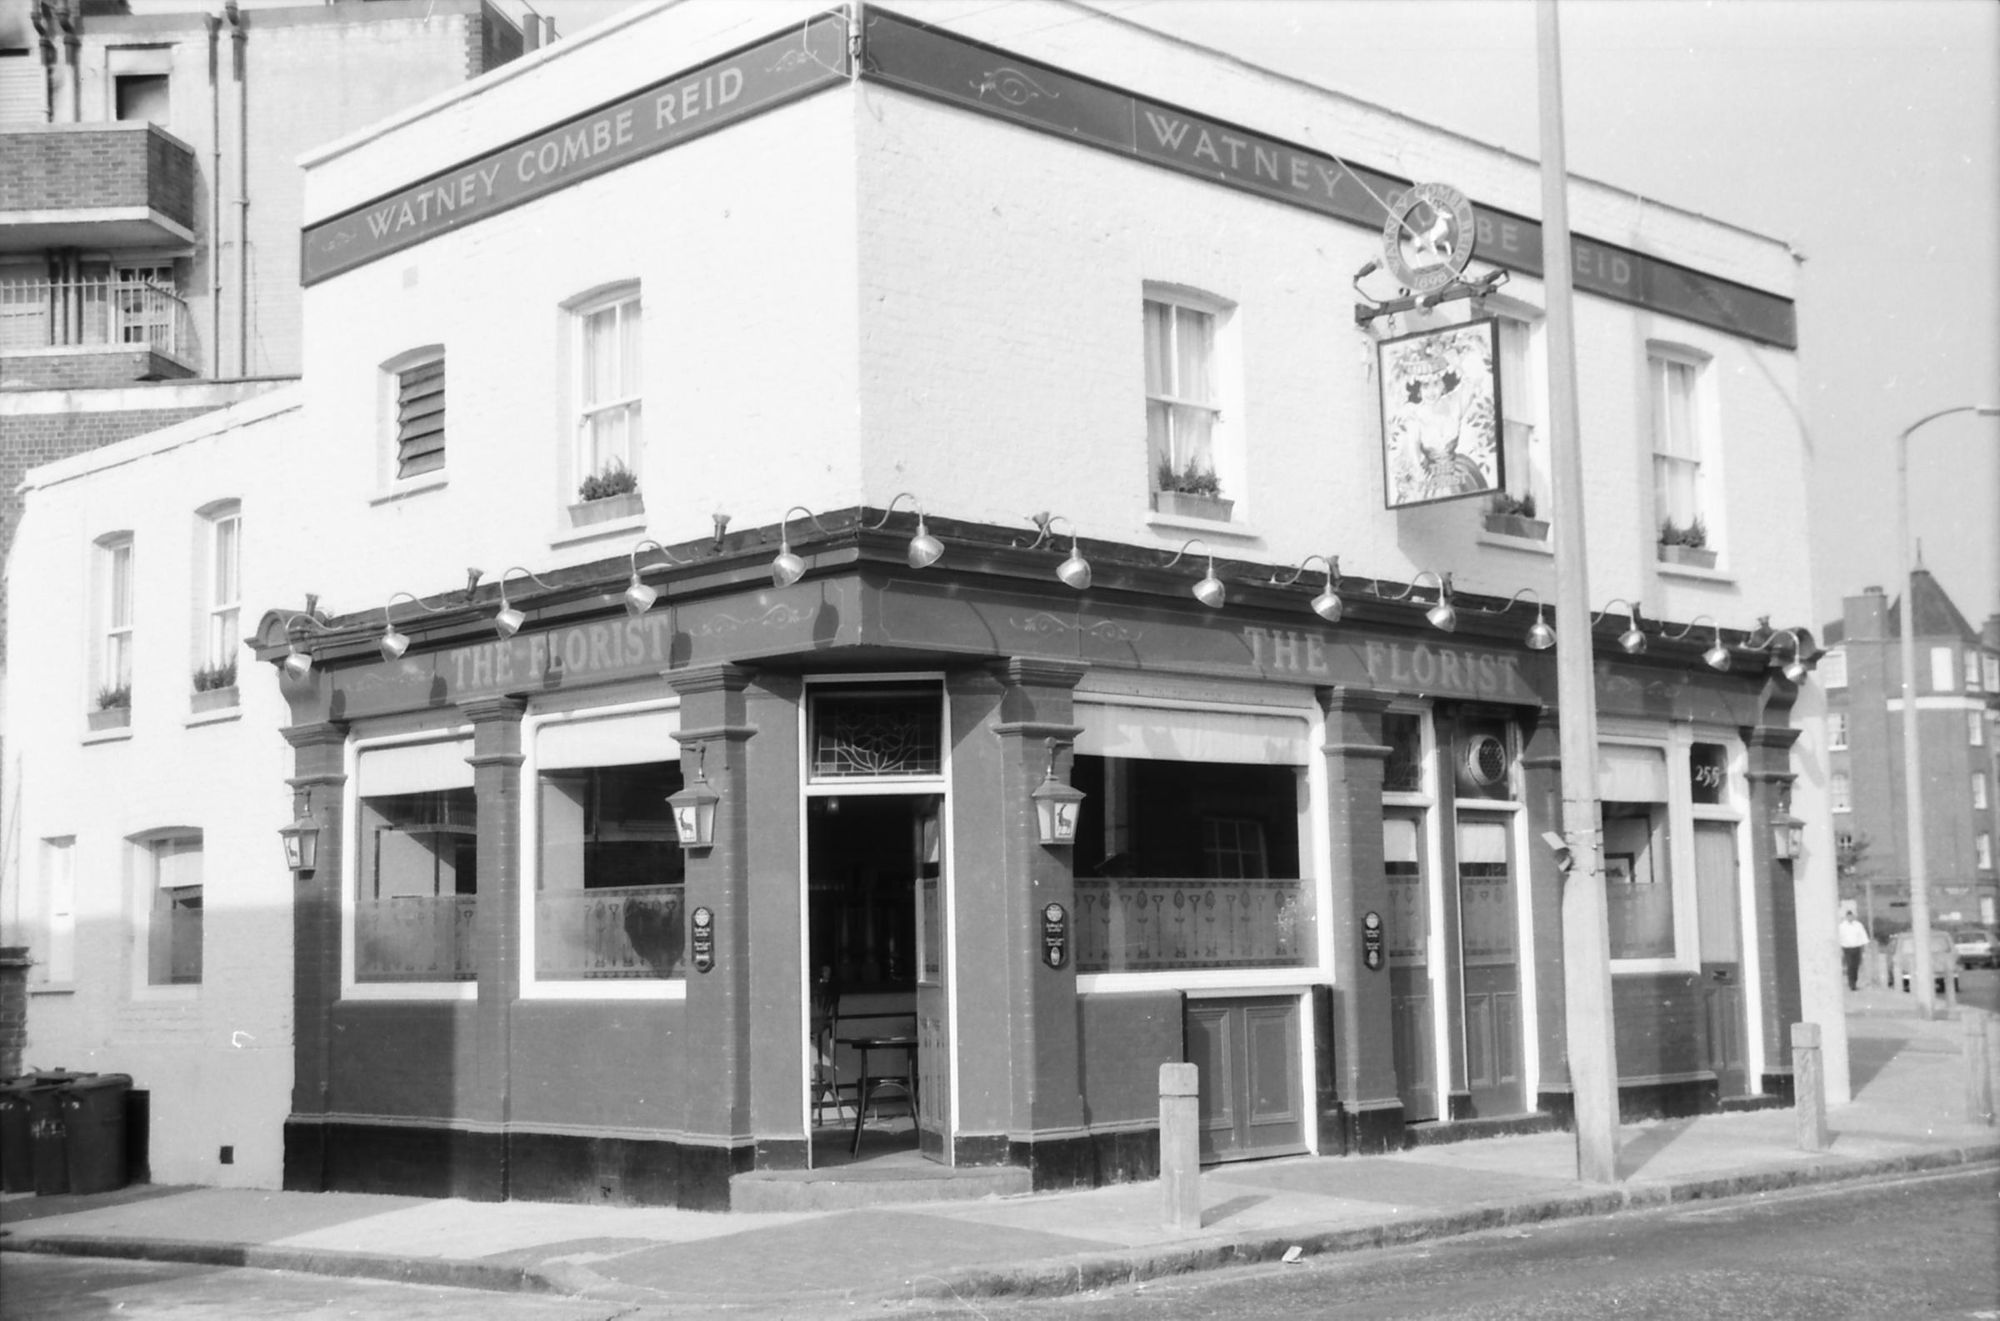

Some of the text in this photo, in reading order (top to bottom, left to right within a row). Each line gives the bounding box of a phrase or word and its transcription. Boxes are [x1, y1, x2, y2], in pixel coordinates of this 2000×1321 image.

[366, 67, 743, 239] WATNEY COMBE REID
[1145, 111, 1343, 199] WATNEY
[1575, 246, 1630, 284] EID
[1414, 271, 1448, 288] 1898
[452, 614, 669, 690] THE FLORIST
[1244, 626, 1518, 695] THE FLORIST
